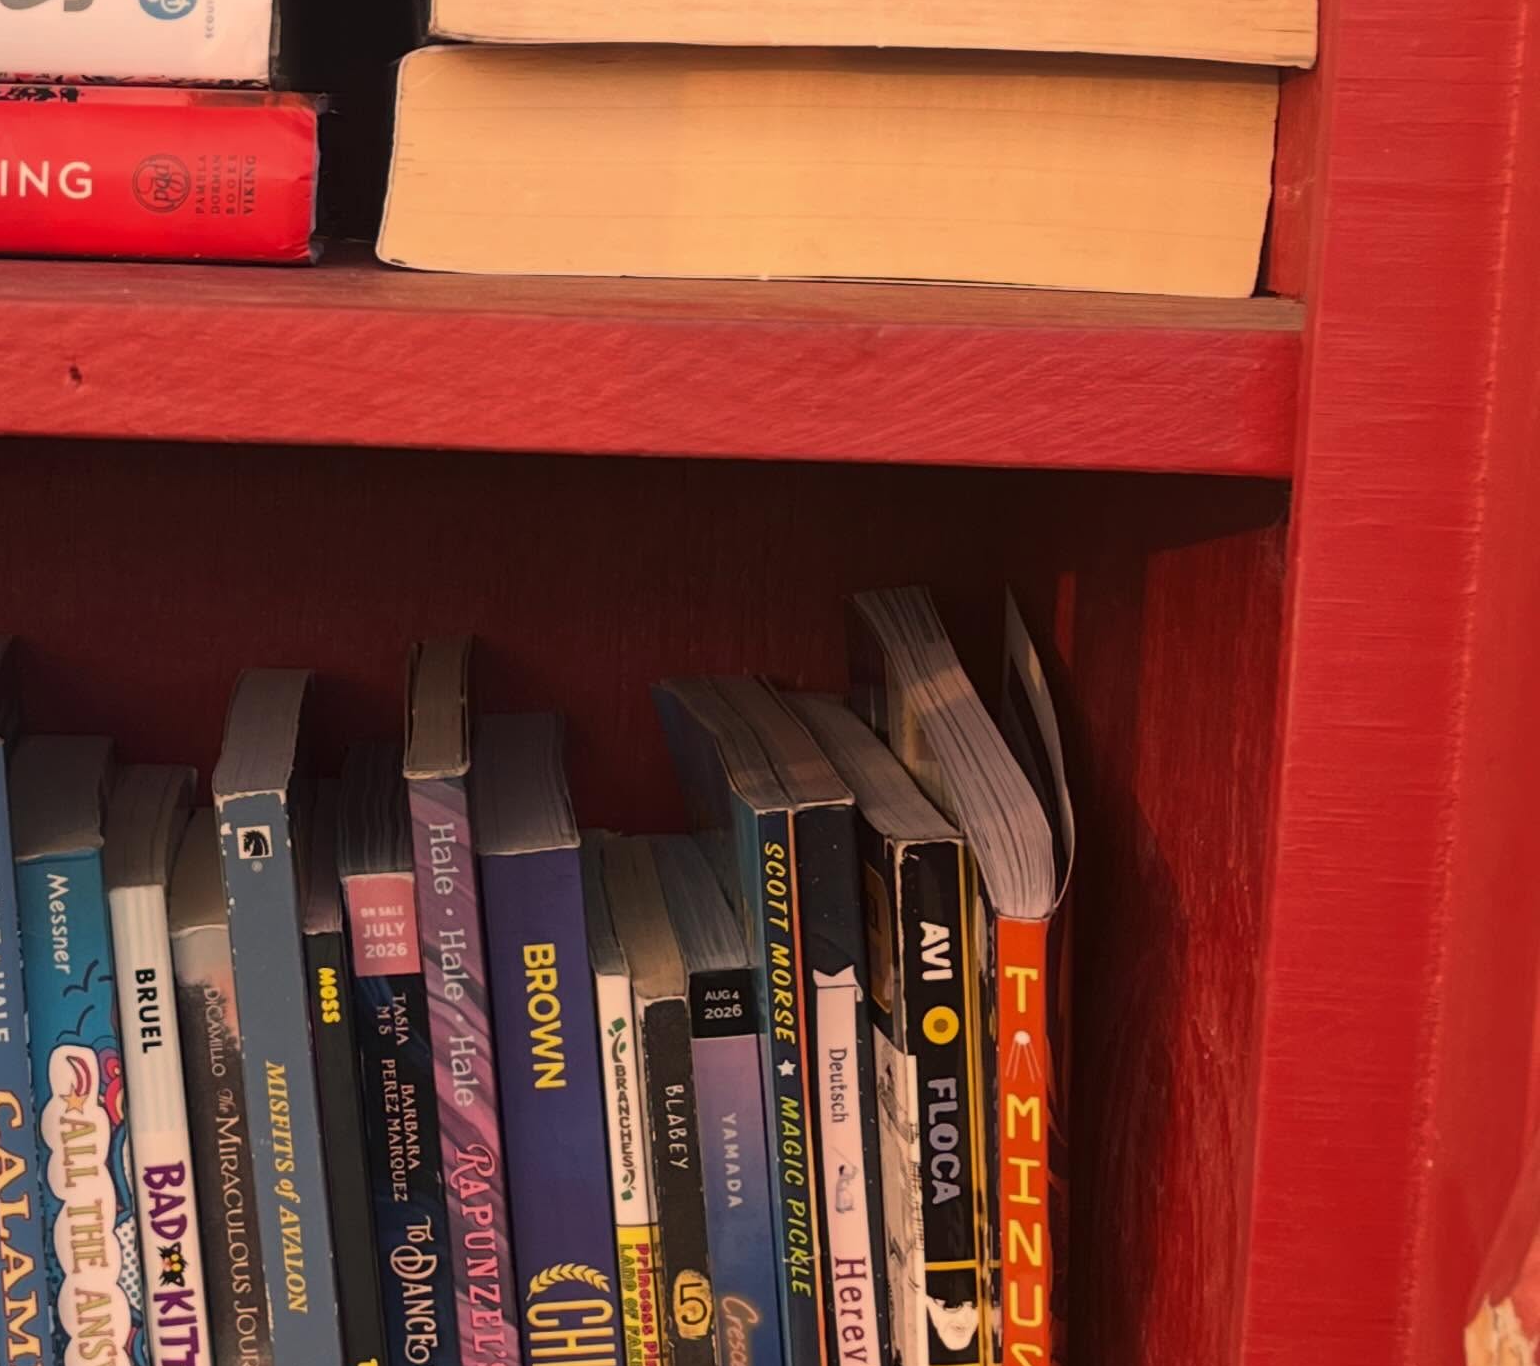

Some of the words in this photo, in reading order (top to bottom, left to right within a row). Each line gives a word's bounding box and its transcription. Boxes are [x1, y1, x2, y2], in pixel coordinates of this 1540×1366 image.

[243, 154, 256, 215] VIKING
[428, 823, 456, 895] Hale
[765, 842, 788, 933] SCOTT
[47, 873, 71, 974] Messner
[363, 923, 405, 937] JULY
[365, 943, 408, 958] 2026
[920, 921, 953, 981] AVI
[318, 967, 341, 1024] MOSS
[439, 930, 467, 1001] Hale
[705, 990, 730, 1001] AUG
[732, 991, 739, 999] 4
[770, 942, 796, 1045] MORSE
[135, 968, 162, 1054] BRUEL
[392, 994, 409, 1045] TASIA
[523, 943, 568, 1089] BROWN
[704, 1005, 743, 1019] 2026
[381, 1058, 398, 1112] PEREZ
[449, 1035, 476, 1107] Hale
[829, 1048, 848, 1124] Deutsch
[59, 1115, 98, 1188] ALL
[266, 1060, 296, 1173] MISFITS
[401, 1084, 421, 1170] BARBARA
[615, 1065, 635, 1171] BRANCHES
[665, 1084, 690, 1170] BLABEY
[779, 1096, 804, 1187] MAGIC
[927, 1077, 960, 1205] FLOCA
[274, 1178, 301, 1204] of
[387, 1118, 408, 1202] MARQUEZ
[722, 1112, 744, 1209] YAMADA
[67, 1202, 108, 1274] THE
[144, 1160, 187, 1240] BAD
[279, 1204, 308, 1313] AVALON
[787, 1199, 811, 1297] PICKLE
[680, 1283, 707, 1325] 5
